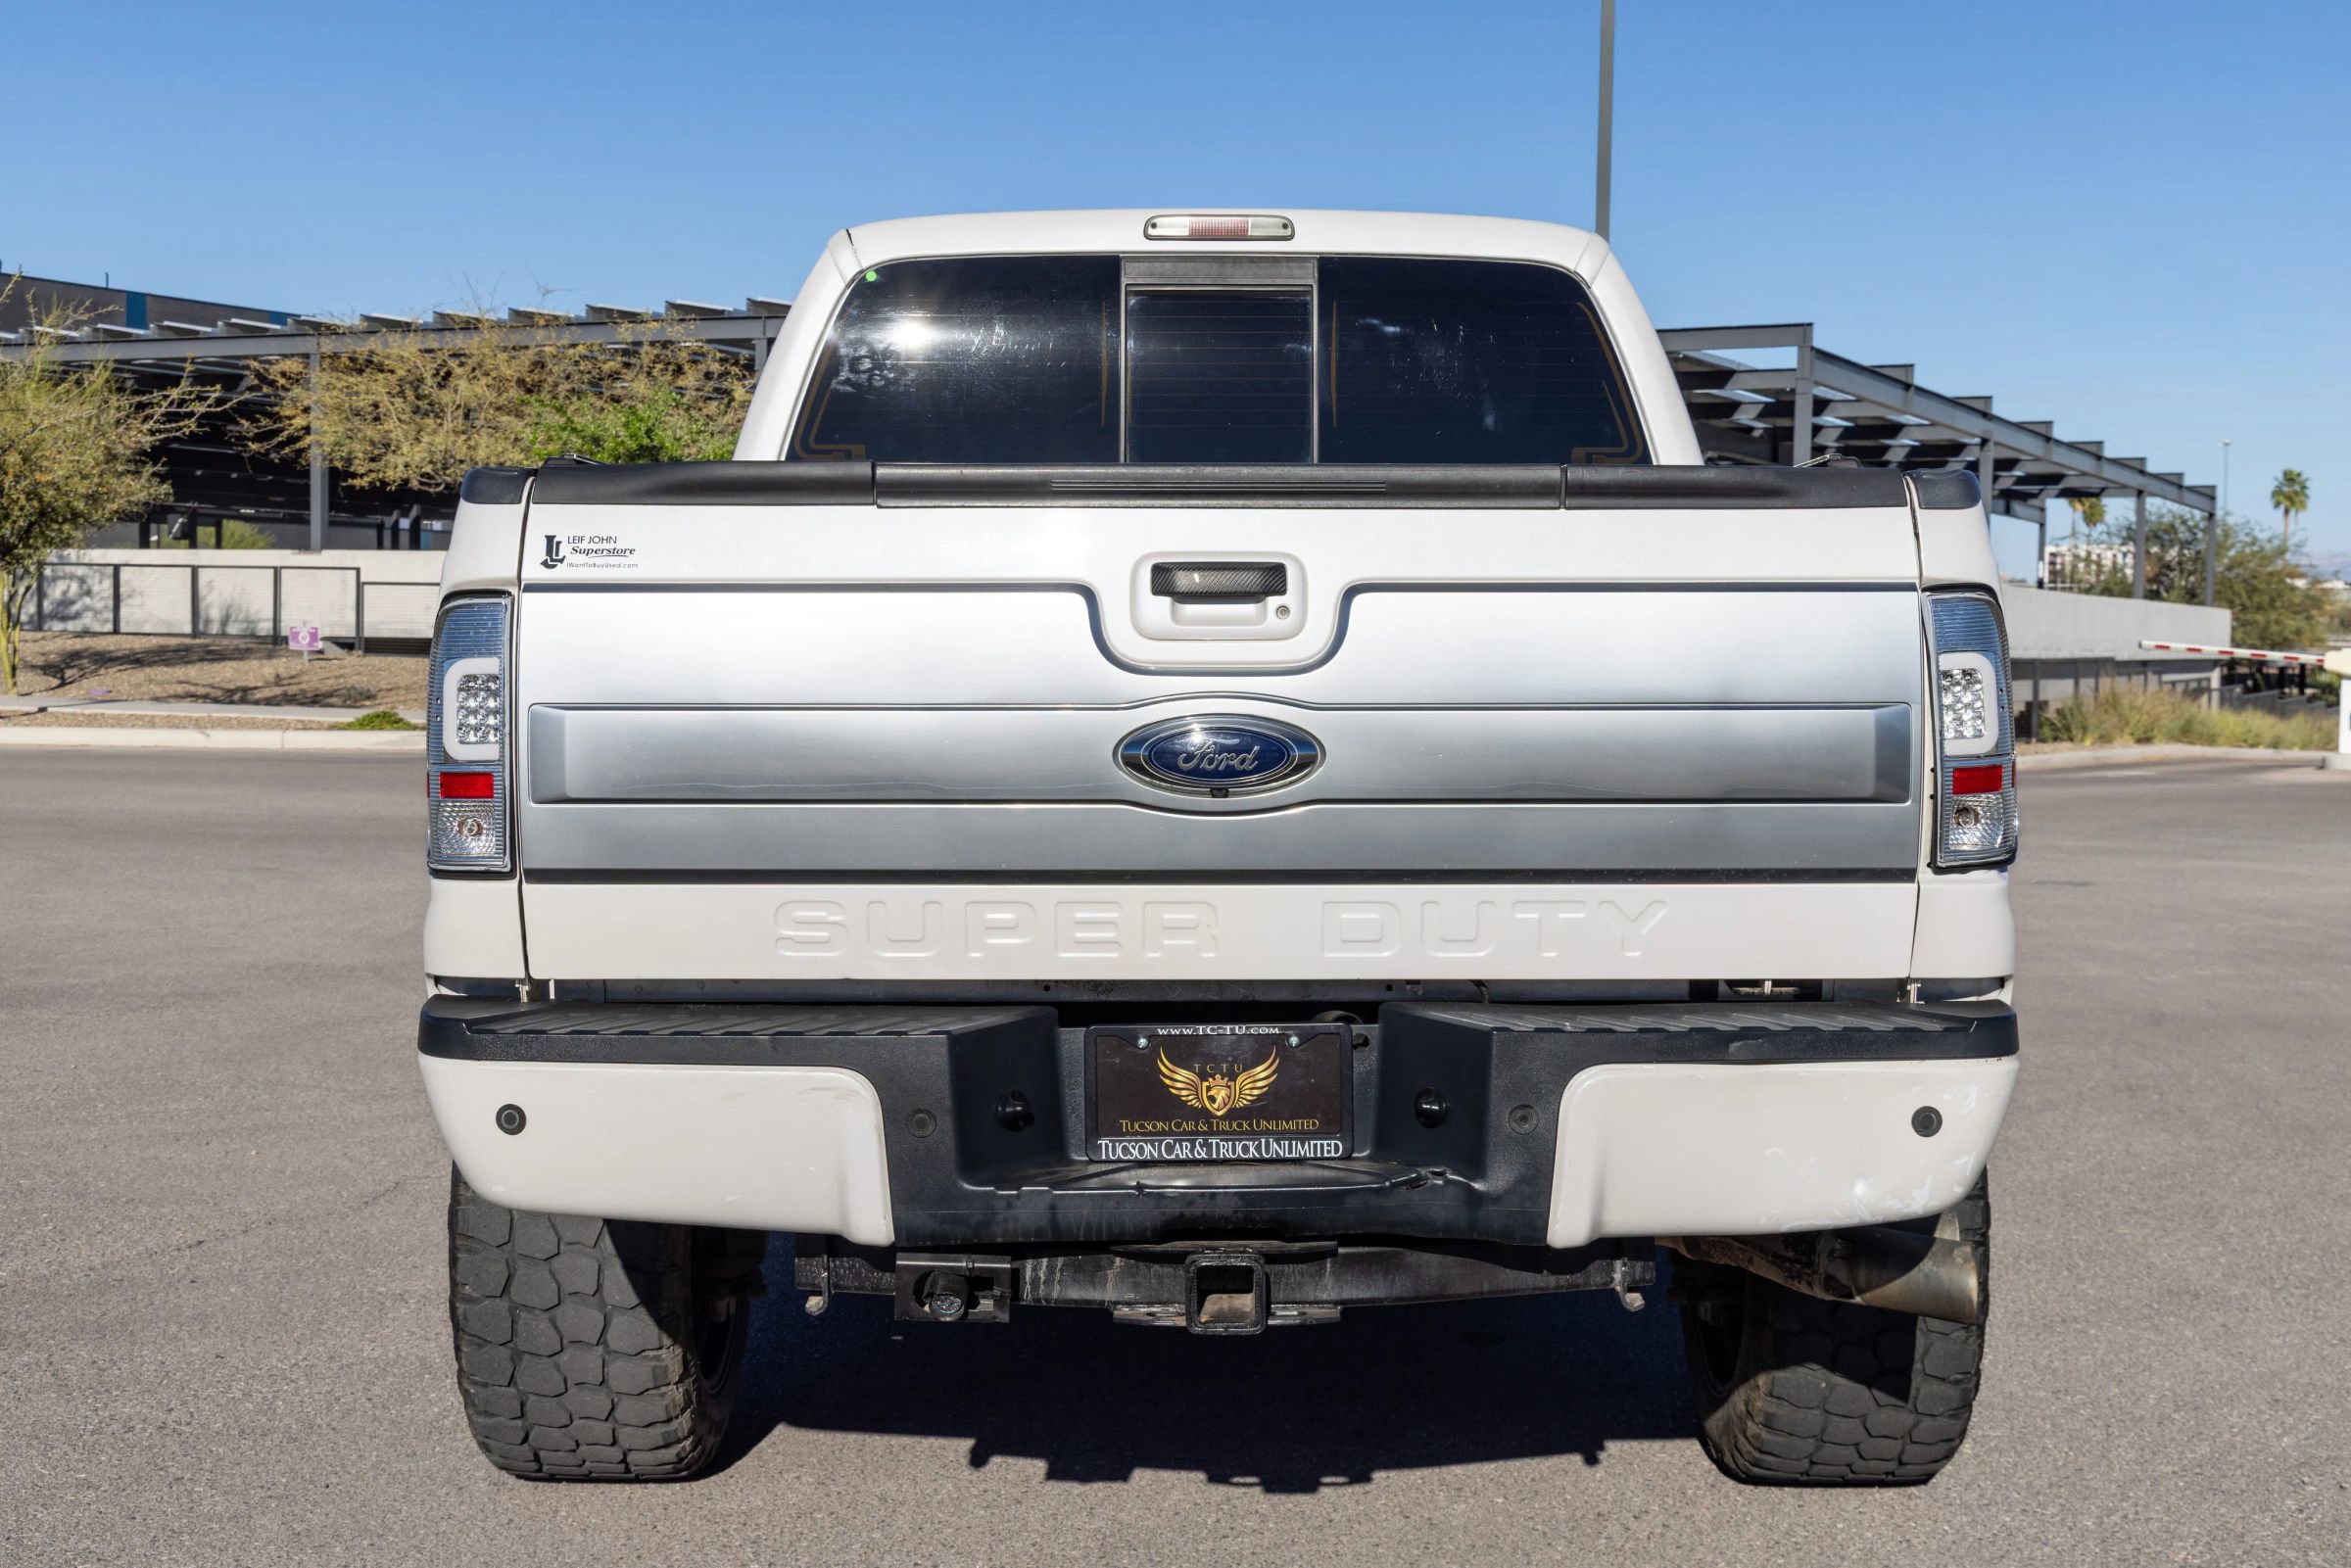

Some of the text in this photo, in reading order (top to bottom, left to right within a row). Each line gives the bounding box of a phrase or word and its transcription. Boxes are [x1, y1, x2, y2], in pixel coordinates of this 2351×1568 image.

[567, 536, 617, 545] LEIF JOHN
[570, 546, 636, 556] Superstore
[1177, 736, 1261, 772] Ford
[774, 899, 1669, 959] SUPER DUTY
[1171, 1118, 1196, 1131] CAR
[1197, 1118, 1209, 1131] &
[1210, 1118, 1251, 1131] TRUCK
[1253, 1118, 1319, 1130] UNLIMITED
[1161, 1139, 1193, 1159] CAR
[1194, 1138, 1208, 1159] &
[1208, 1139, 1260, 1159] TRUCK
[1260, 1138, 1343, 1158] UNLIMITED
